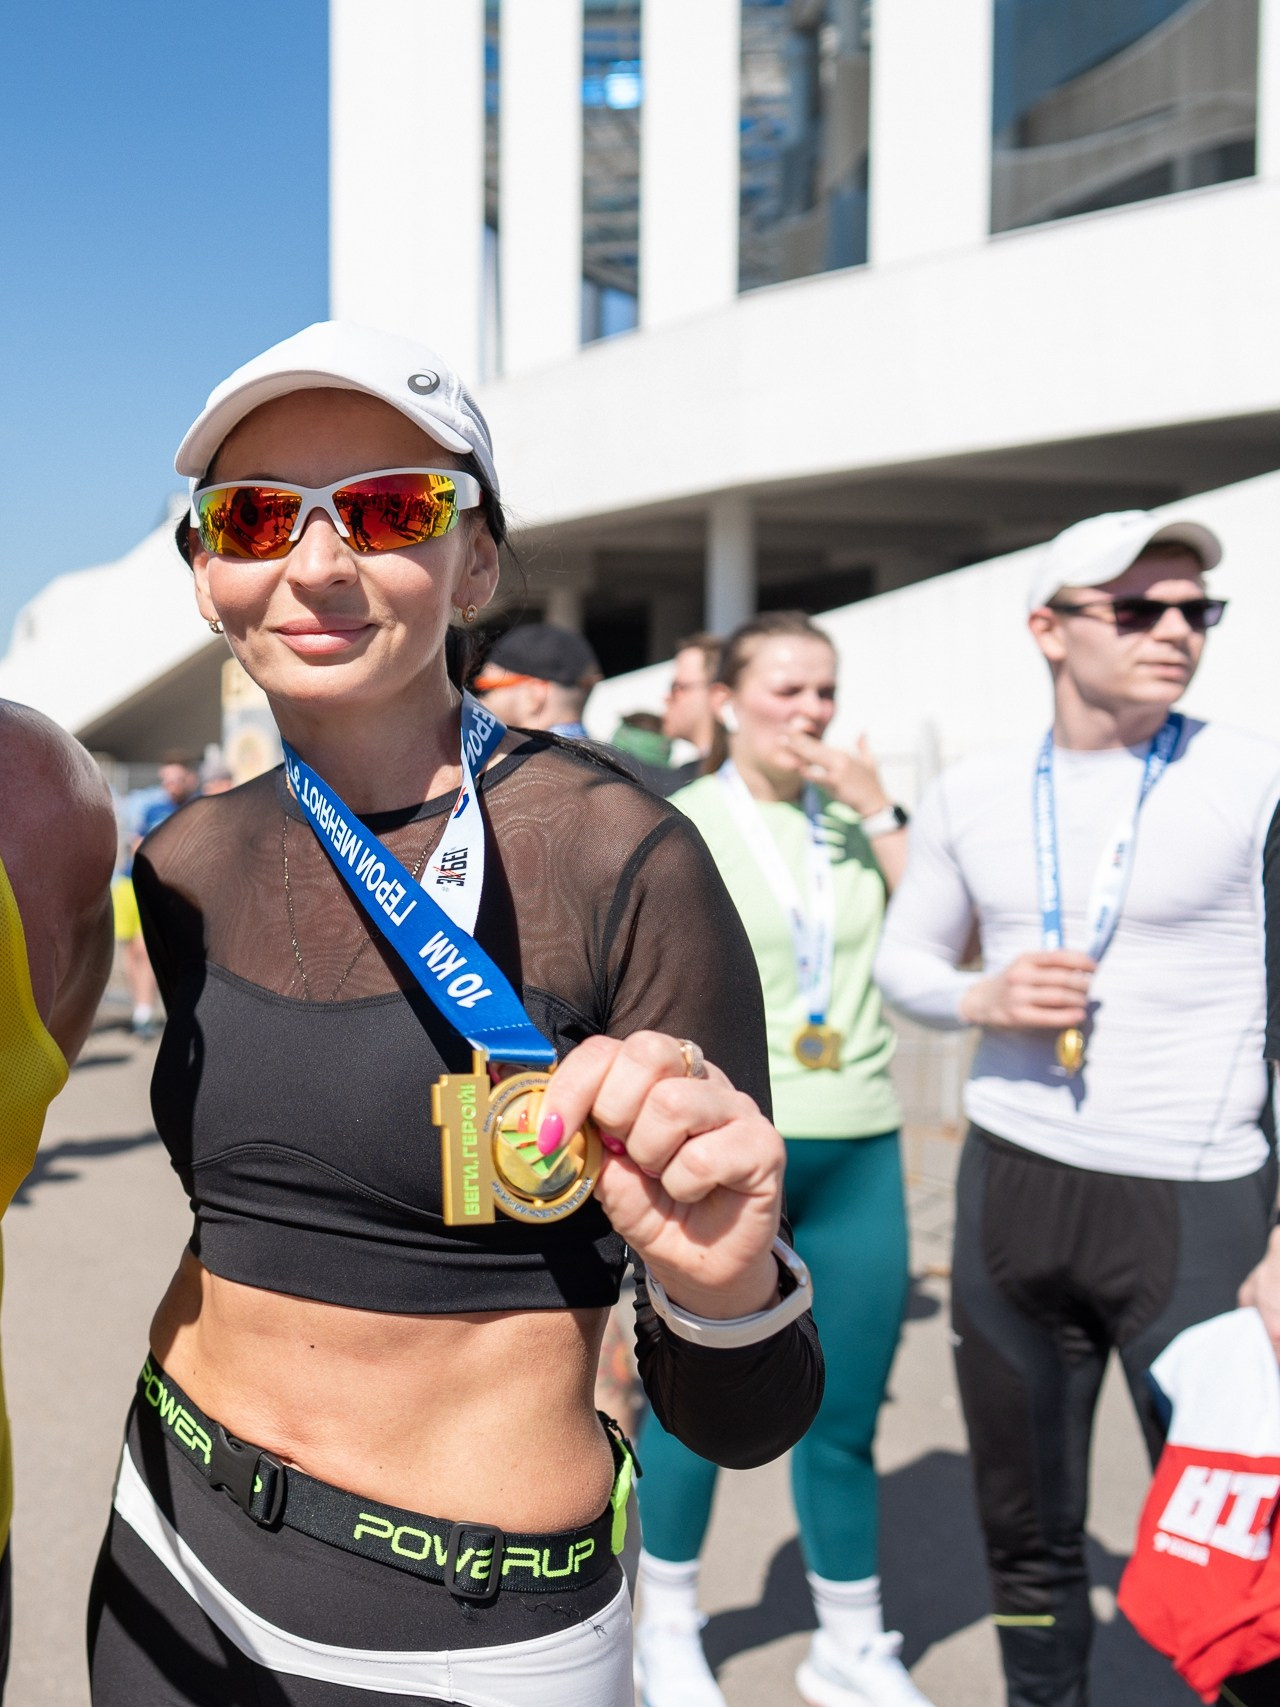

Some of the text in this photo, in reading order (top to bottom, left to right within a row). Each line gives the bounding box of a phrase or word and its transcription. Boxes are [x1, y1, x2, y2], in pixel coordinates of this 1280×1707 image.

[300, 777, 358, 867] МЕНЯЮТ
[355, 848, 417, 926] ГЕРОИ
[419, 930, 493, 1008] 10 КМ
[353, 1512, 595, 1579] POWERUP
